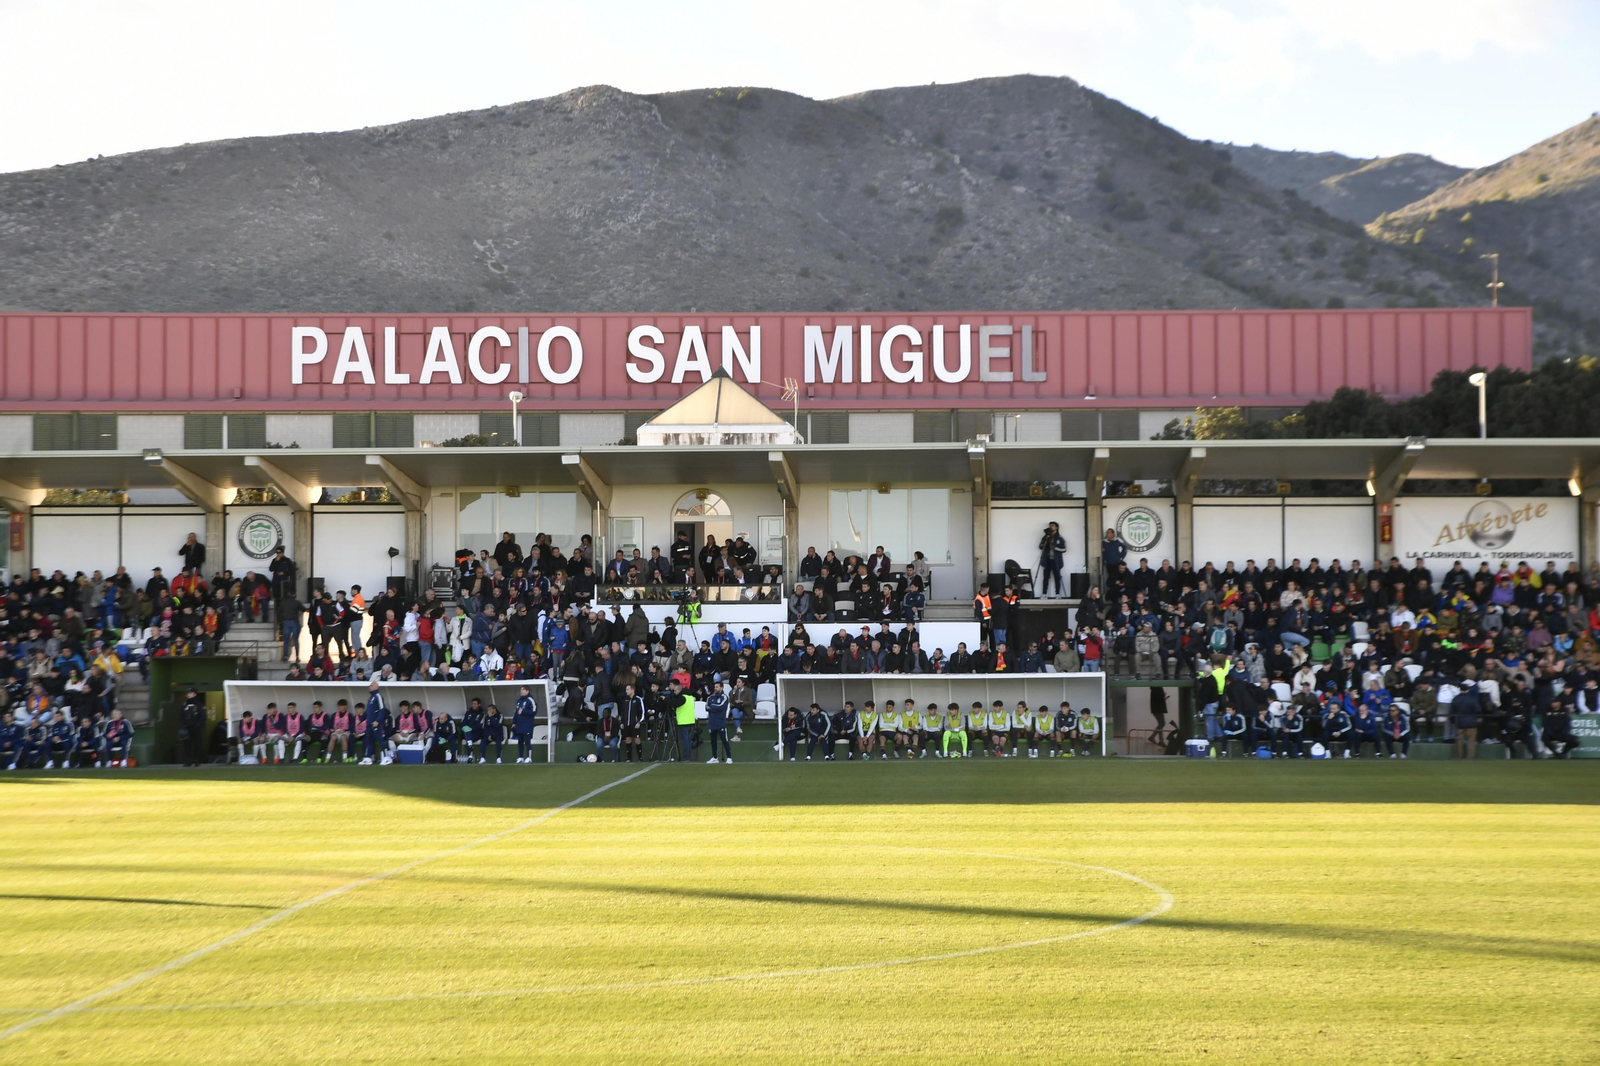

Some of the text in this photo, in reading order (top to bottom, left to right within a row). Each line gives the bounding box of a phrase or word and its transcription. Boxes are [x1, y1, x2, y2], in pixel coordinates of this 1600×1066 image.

[292, 324, 1047, 385] PALACIO SAN MIGUEL
[1432, 502, 1548, 547] Atrévete
[1406, 551, 1420, 559] LA
[1422, 551, 1481, 559] CARIHUELA
[1490, 551, 1575, 559] TORREMOLINOS
[1571, 719, 1599, 728] OTEL
